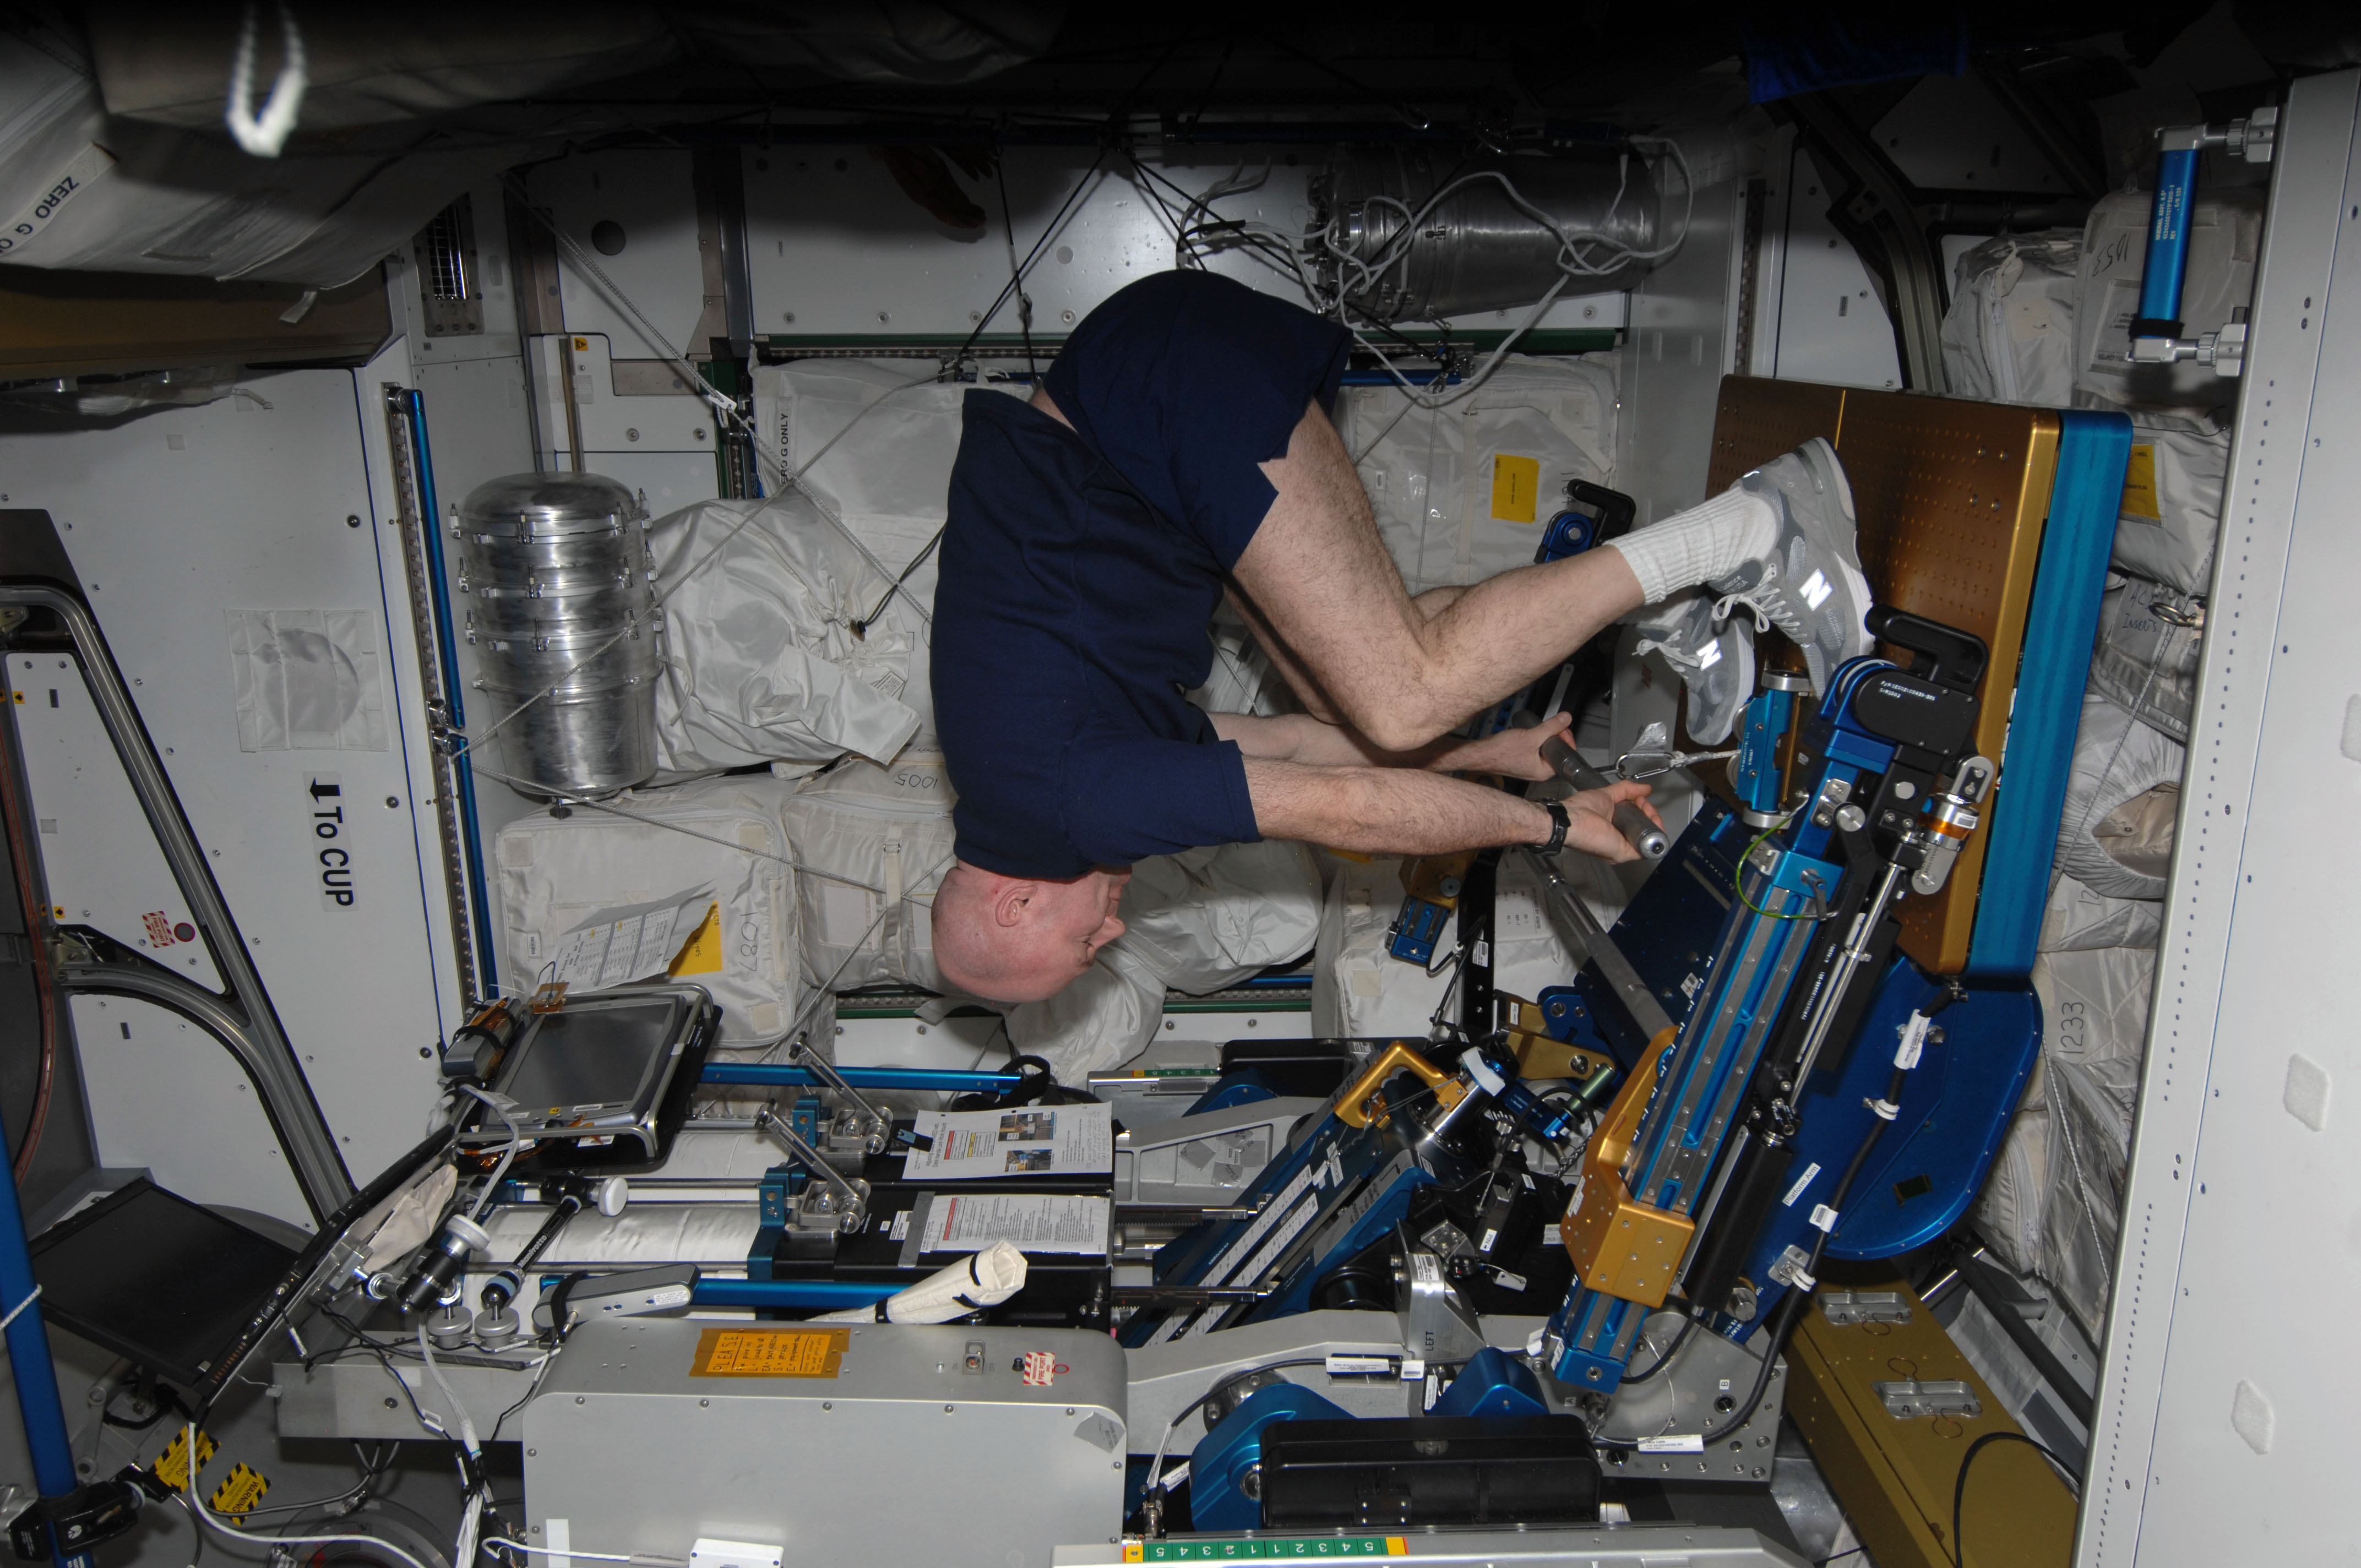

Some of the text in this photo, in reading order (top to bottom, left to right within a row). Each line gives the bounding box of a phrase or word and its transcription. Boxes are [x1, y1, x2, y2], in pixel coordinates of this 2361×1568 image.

[36, 176, 79, 220] ZERO
[15, 222, 33, 236] G
[1798, 568, 1832, 611] N
[895, 773, 938, 789] 1005
[313, 806, 355, 908] To CUP
[740, 912, 759, 972] 1087
[2058, 1000, 2085, 1055] 1233
[1783, 1165, 1818, 1206] Platform Arm
[712, 1335, 739, 1370] PLEASE
[1424, 1331, 1435, 1351] LEFT
[231, 1480, 260, 1514] WARNING
[1156, 1542, 1373, 1557] 5 4 3 2 1 1 2 3 4 5
